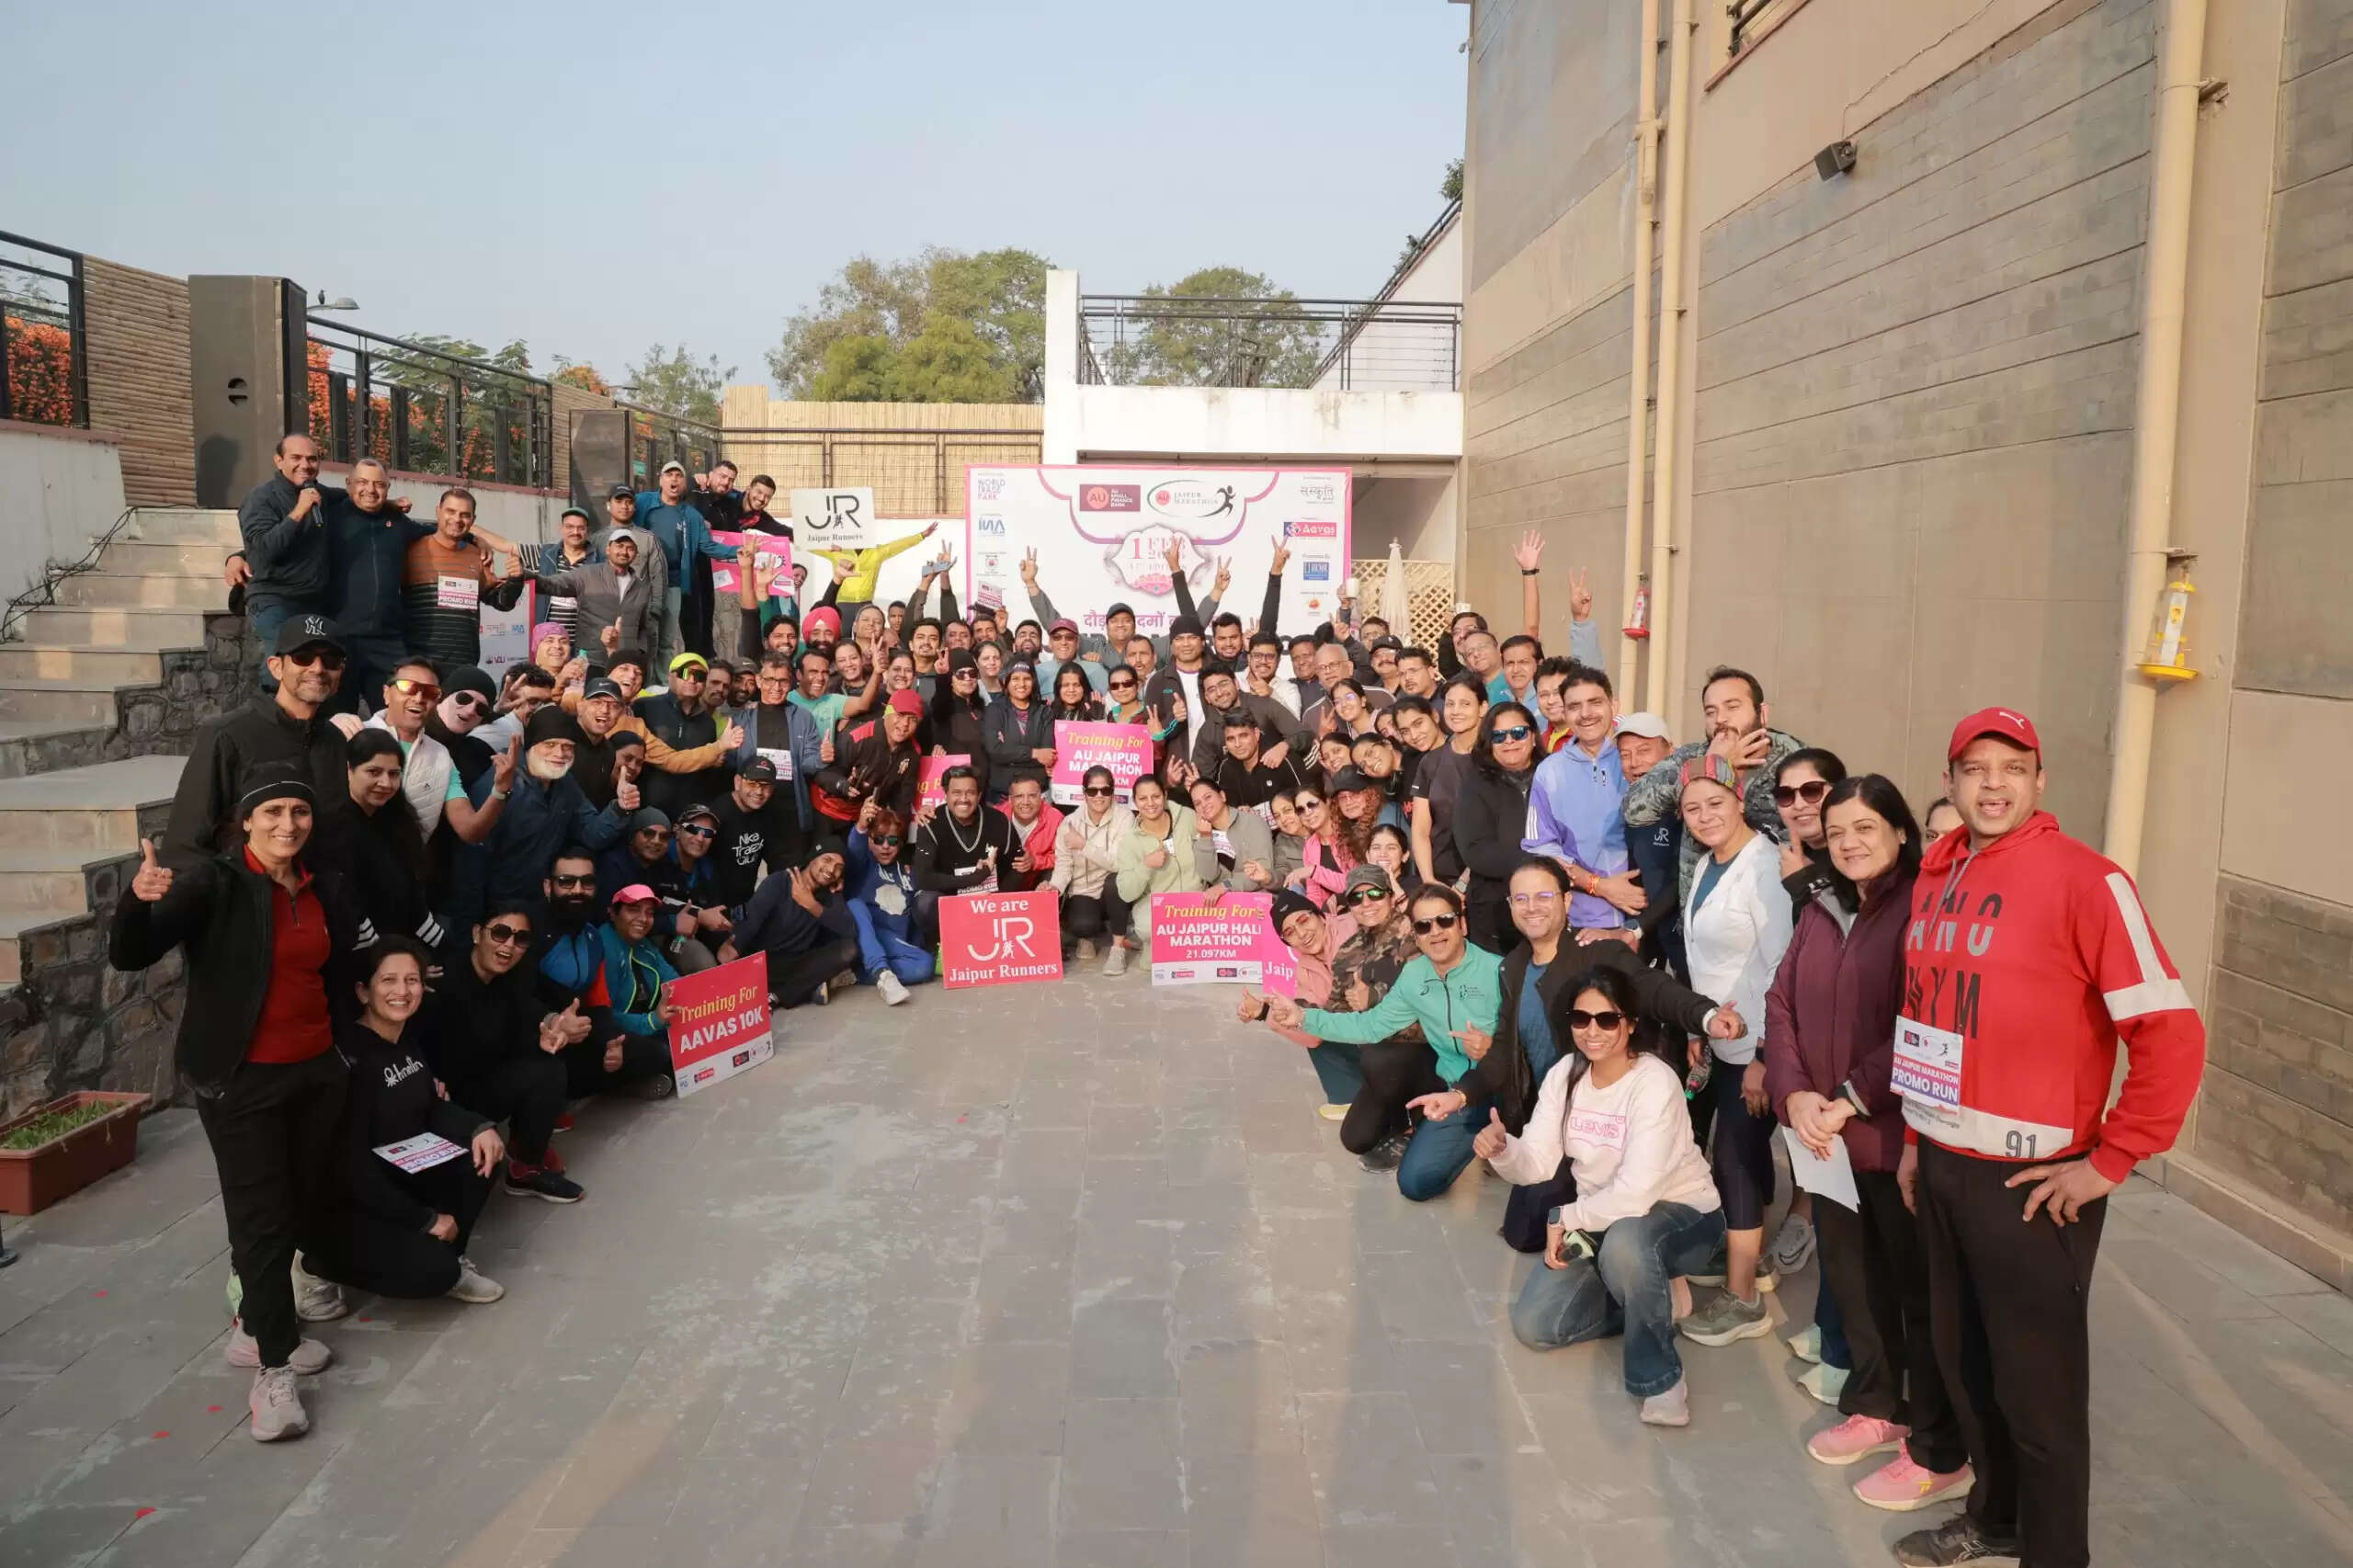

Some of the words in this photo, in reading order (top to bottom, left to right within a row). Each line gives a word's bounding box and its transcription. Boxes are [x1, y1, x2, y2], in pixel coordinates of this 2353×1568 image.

[1088, 493, 1107, 502] AU
[804, 494, 861, 529] JR
[808, 534, 830, 543] Jaipur
[832, 533, 863, 541] Runners
[1067, 732, 1125, 750] Training
[1127, 735, 1144, 747] For
[1073, 749, 1092, 761] AU
[1095, 750, 1141, 764] JAIPUR
[970, 899, 996, 914] We
[1000, 899, 1029, 912] are
[1165, 903, 1228, 920] Training
[1231, 903, 1256, 918] For
[967, 916, 1037, 961] JR
[1156, 925, 1176, 936] AU
[1178, 923, 1229, 935] JAIPUR
[1170, 936, 1252, 947] MARATHON
[1186, 949, 1236, 959] 21.097KM
[949, 967, 996, 984] Jaipur
[999, 963, 1058, 979] Runners
[1265, 960, 1294, 981] Jaip
[678, 994, 736, 1025] Training
[739, 984, 758, 1004] For
[680, 1017, 738, 1054] AAVAS
[739, 1005, 765, 1030] 10K
[1921, 1063, 1960, 1085] MARATHON
[1892, 1066, 1931, 1093] PROMO
[1931, 1082, 1959, 1104] RUN
[2005, 1130, 2038, 1160] 91
